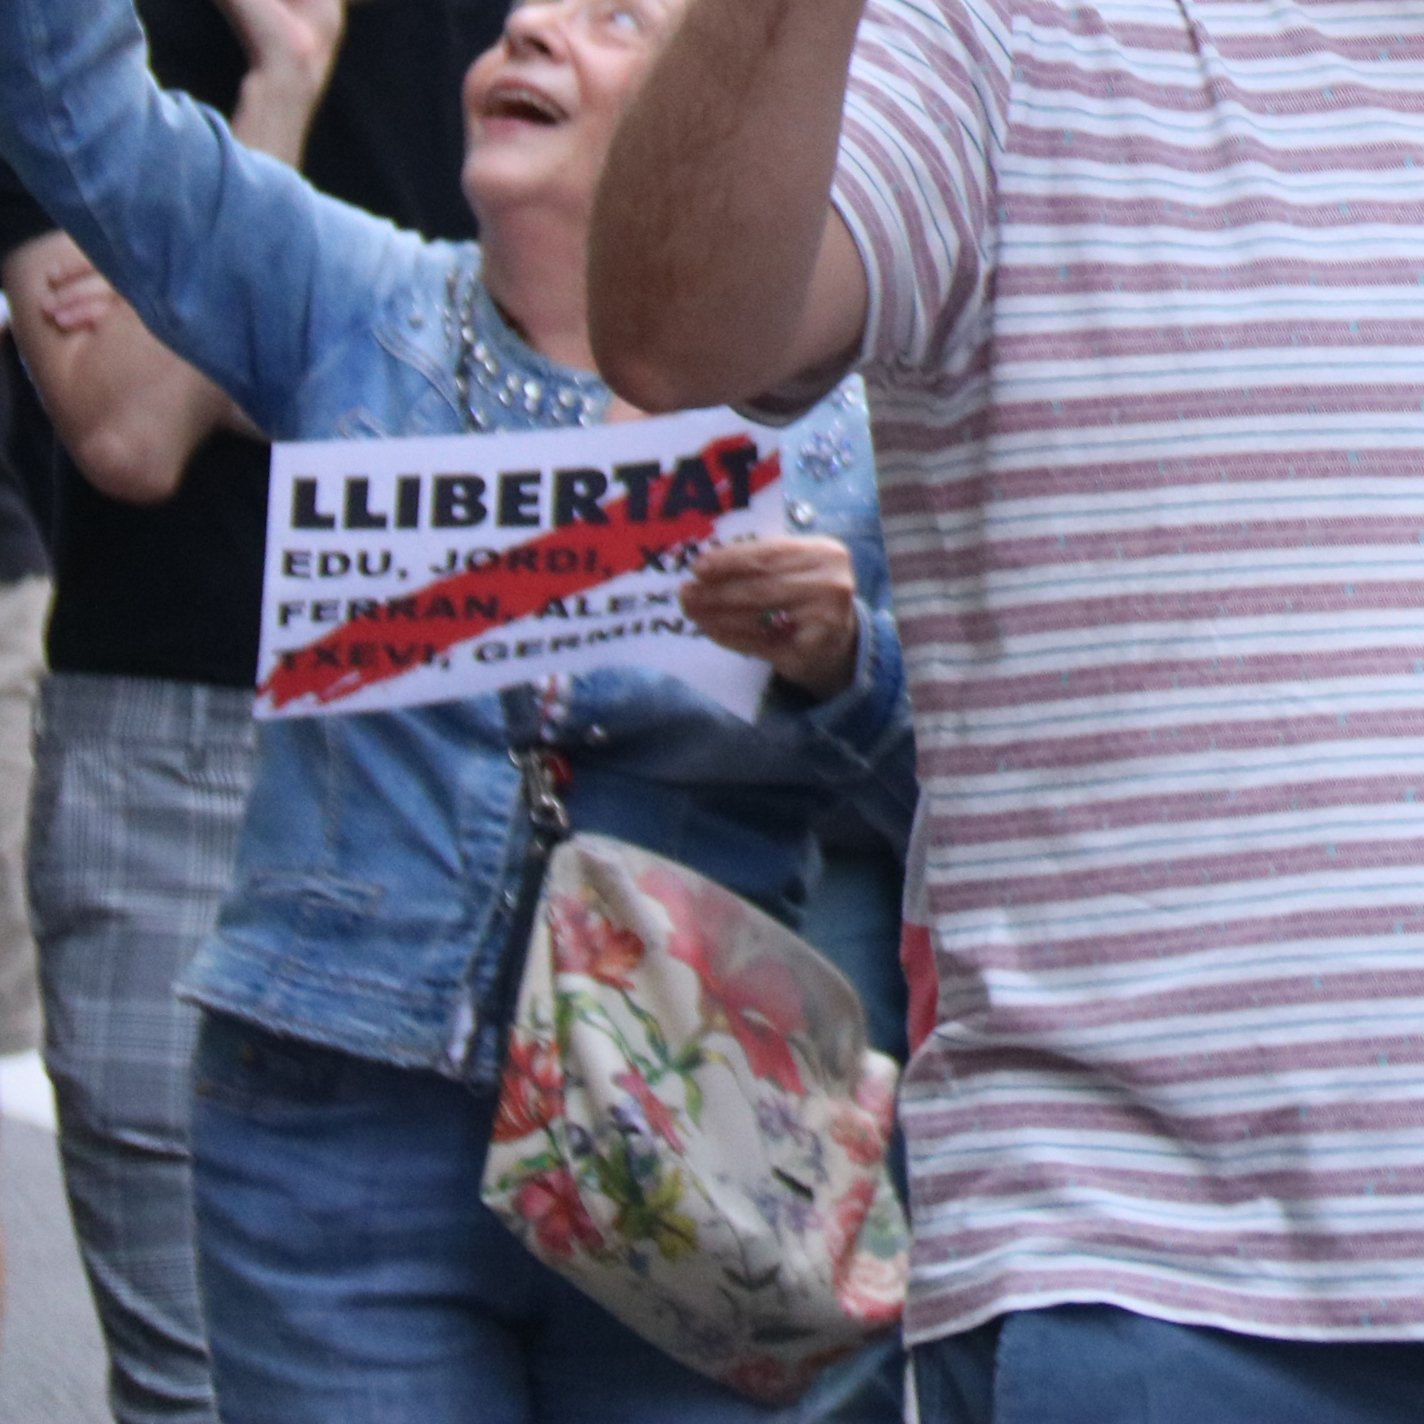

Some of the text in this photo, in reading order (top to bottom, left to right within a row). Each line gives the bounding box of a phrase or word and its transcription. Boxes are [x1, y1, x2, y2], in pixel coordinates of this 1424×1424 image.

[291, 444, 757, 530] LLIBERTAT
[281, 549, 408, 580] EDU,
[430, 545, 613, 579] JORDI,
[278, 590, 672, 627] FERRAN, ALEX
[274, 617, 706, 671] TXEVI, GERMIN
